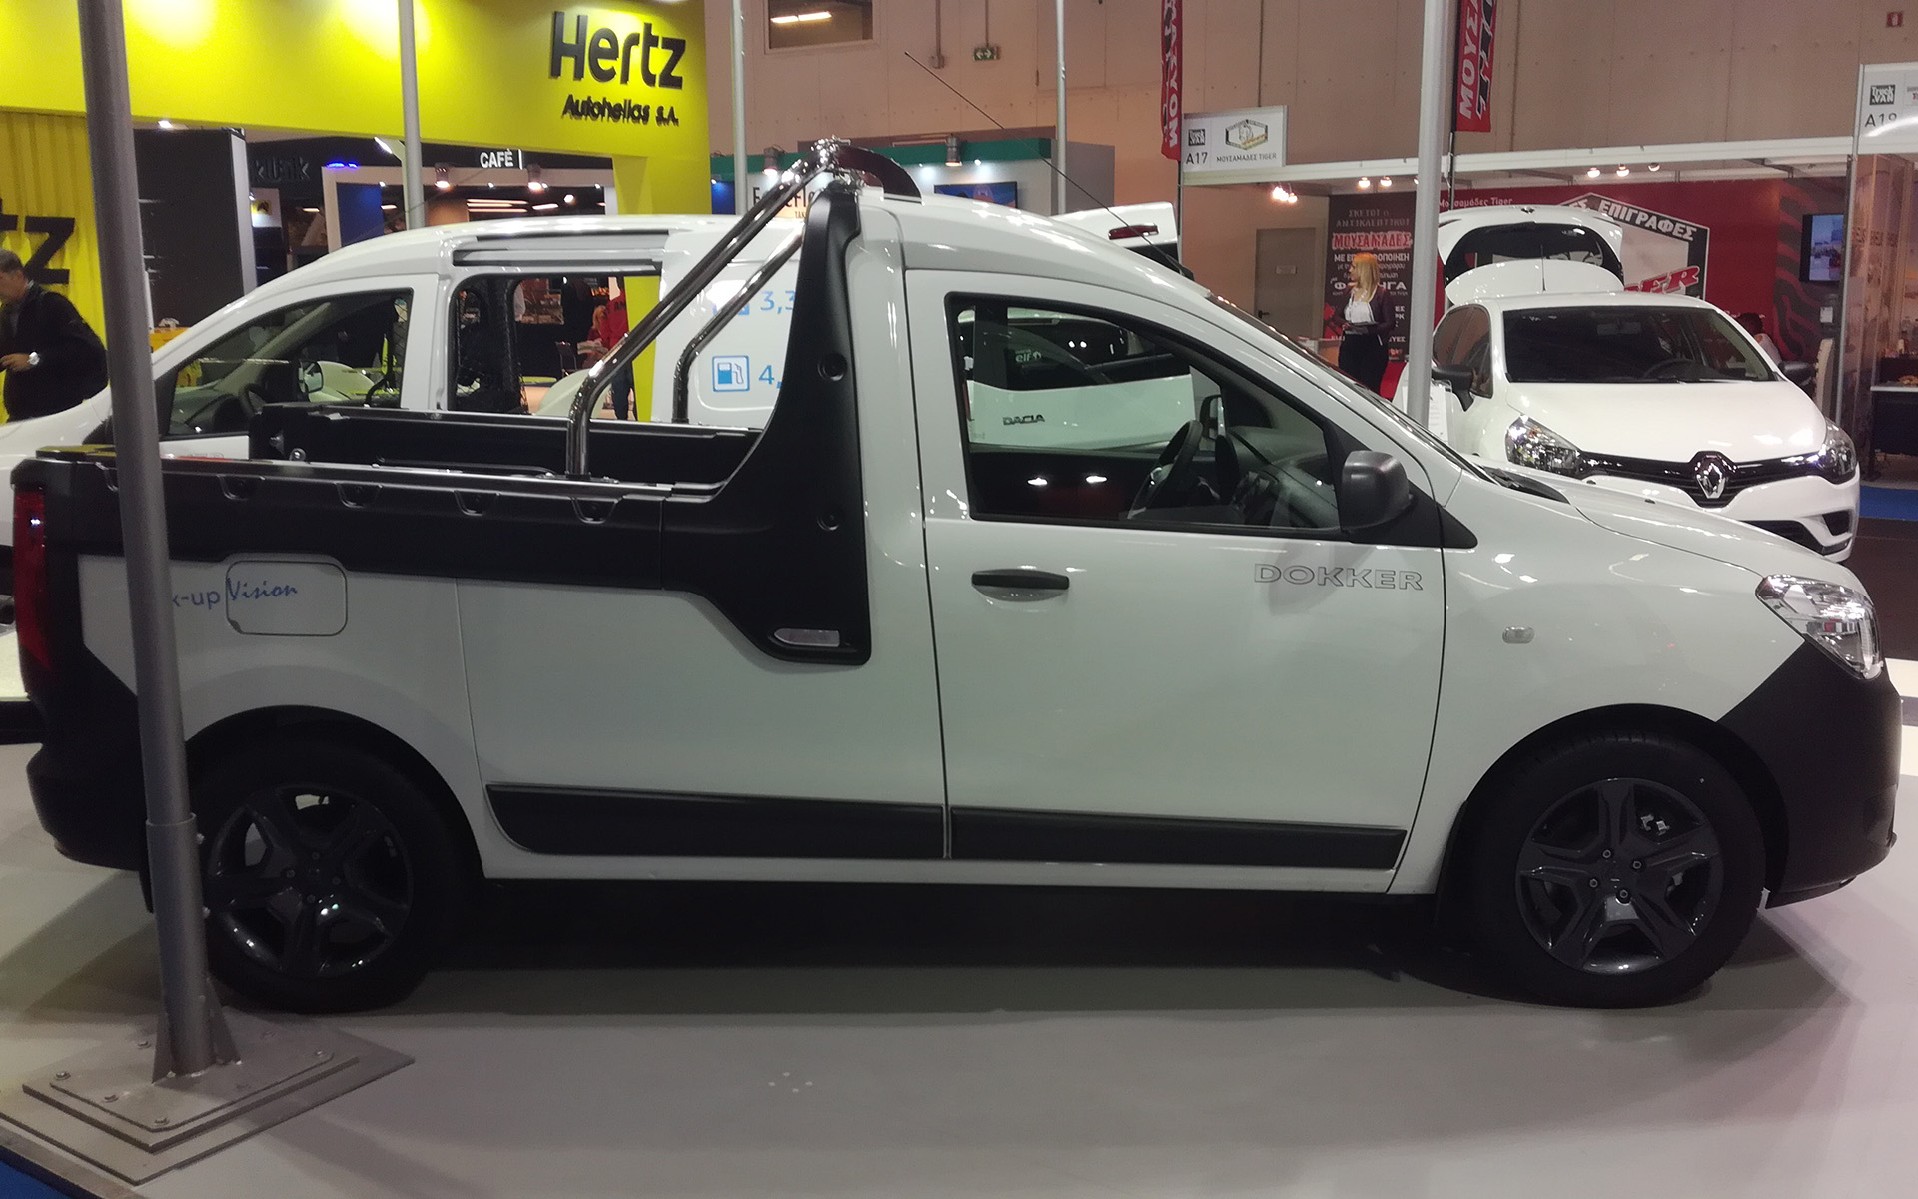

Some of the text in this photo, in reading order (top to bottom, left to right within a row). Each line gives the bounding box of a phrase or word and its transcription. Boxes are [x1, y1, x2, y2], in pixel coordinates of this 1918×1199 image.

[549, 11, 686, 90] Hertz
[562, 94, 650, 124] Autohellas
[1185, 152, 1208, 165] A17
[1258, 152, 1277, 161] TIGER
[1598, 199, 1697, 241] ΕΠΙΓΡΑΦΕΣ
[1002, 414, 1045, 426] DACIA
[225, 577, 299, 601] Vision
[1254, 563, 1424, 591] DOKKER
